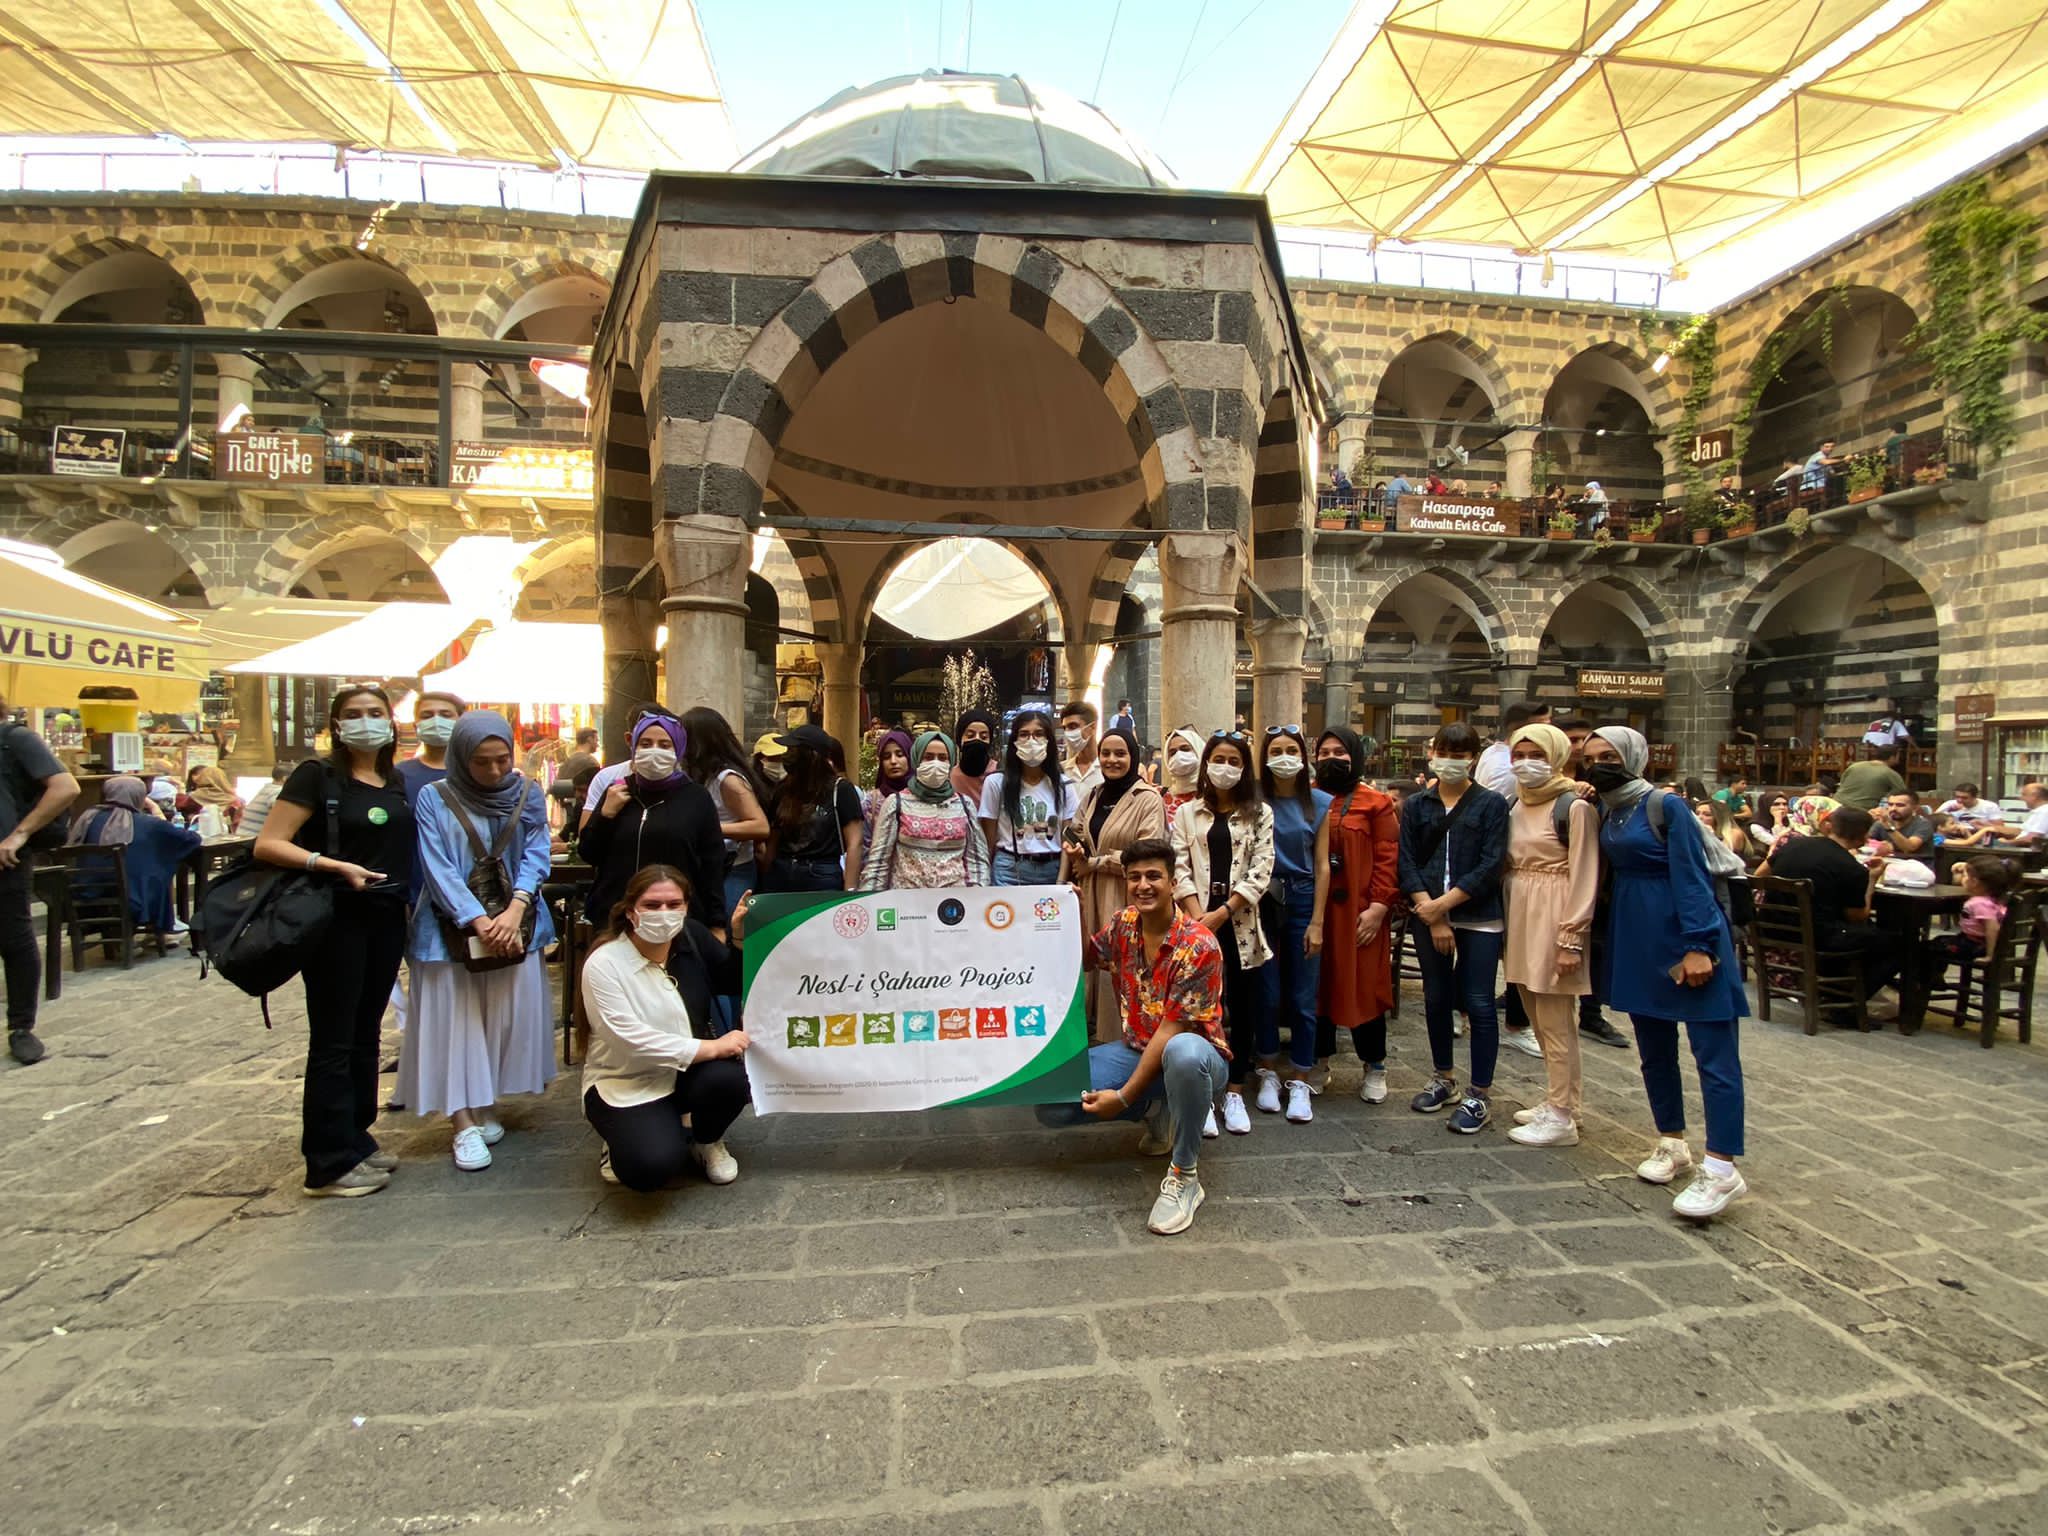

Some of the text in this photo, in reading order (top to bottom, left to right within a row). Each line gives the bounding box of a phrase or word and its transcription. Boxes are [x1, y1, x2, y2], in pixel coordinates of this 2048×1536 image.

[248, 436, 280, 450] CAFE
[1691, 436, 1721, 462] Jan
[1422, 500, 1495, 519] Hasanpaşa
[1410, 517, 1506, 533] Kahvaltı Evi & Cafe
[88, 638, 175, 672] CAFE
[1581, 674, 1663, 686] KAHVALTI SARAYI
[797, 966, 1035, 998] Nesl-i Şahane Projesi
